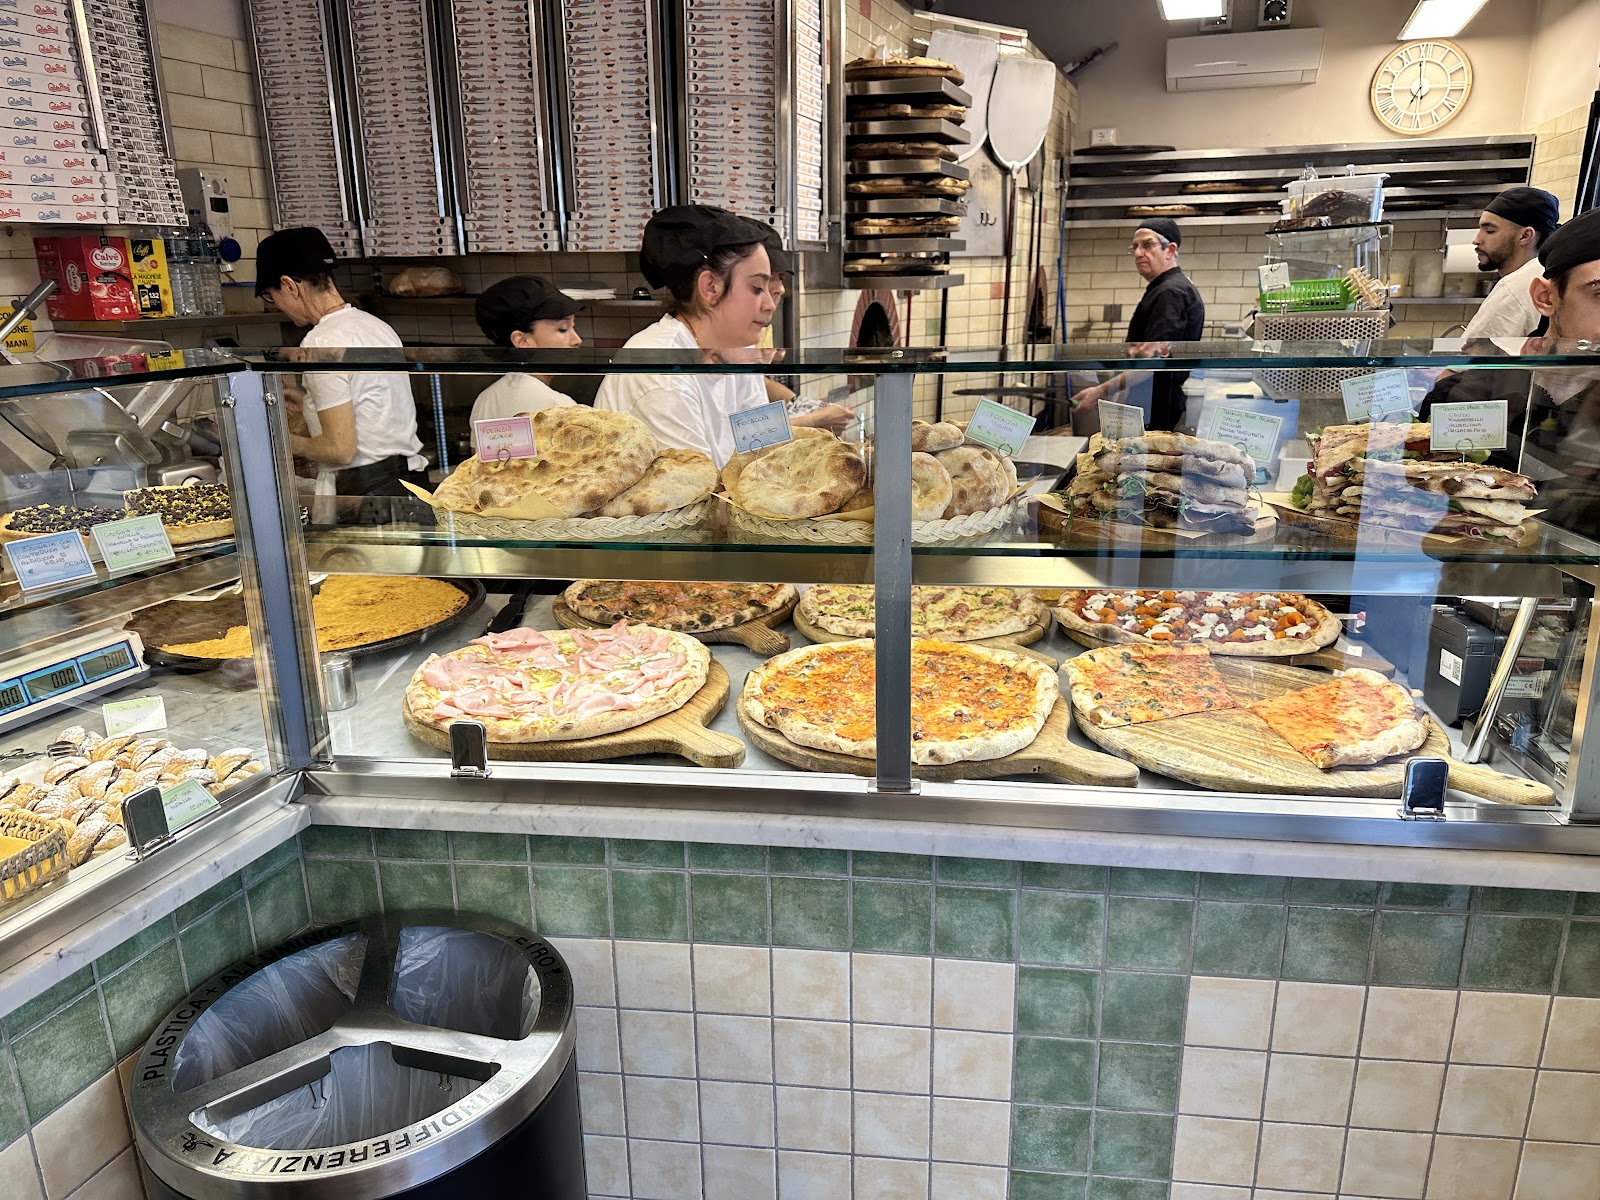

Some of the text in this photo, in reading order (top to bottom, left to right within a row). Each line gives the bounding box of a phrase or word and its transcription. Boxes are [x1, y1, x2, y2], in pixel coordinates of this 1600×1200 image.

[95, 252, 119, 261] Calvé
[6, 340, 29, 348] MANI
[143, 999, 208, 1081] PLASTICA
[212, 1093, 490, 1172] INDIFFERENZIATA
